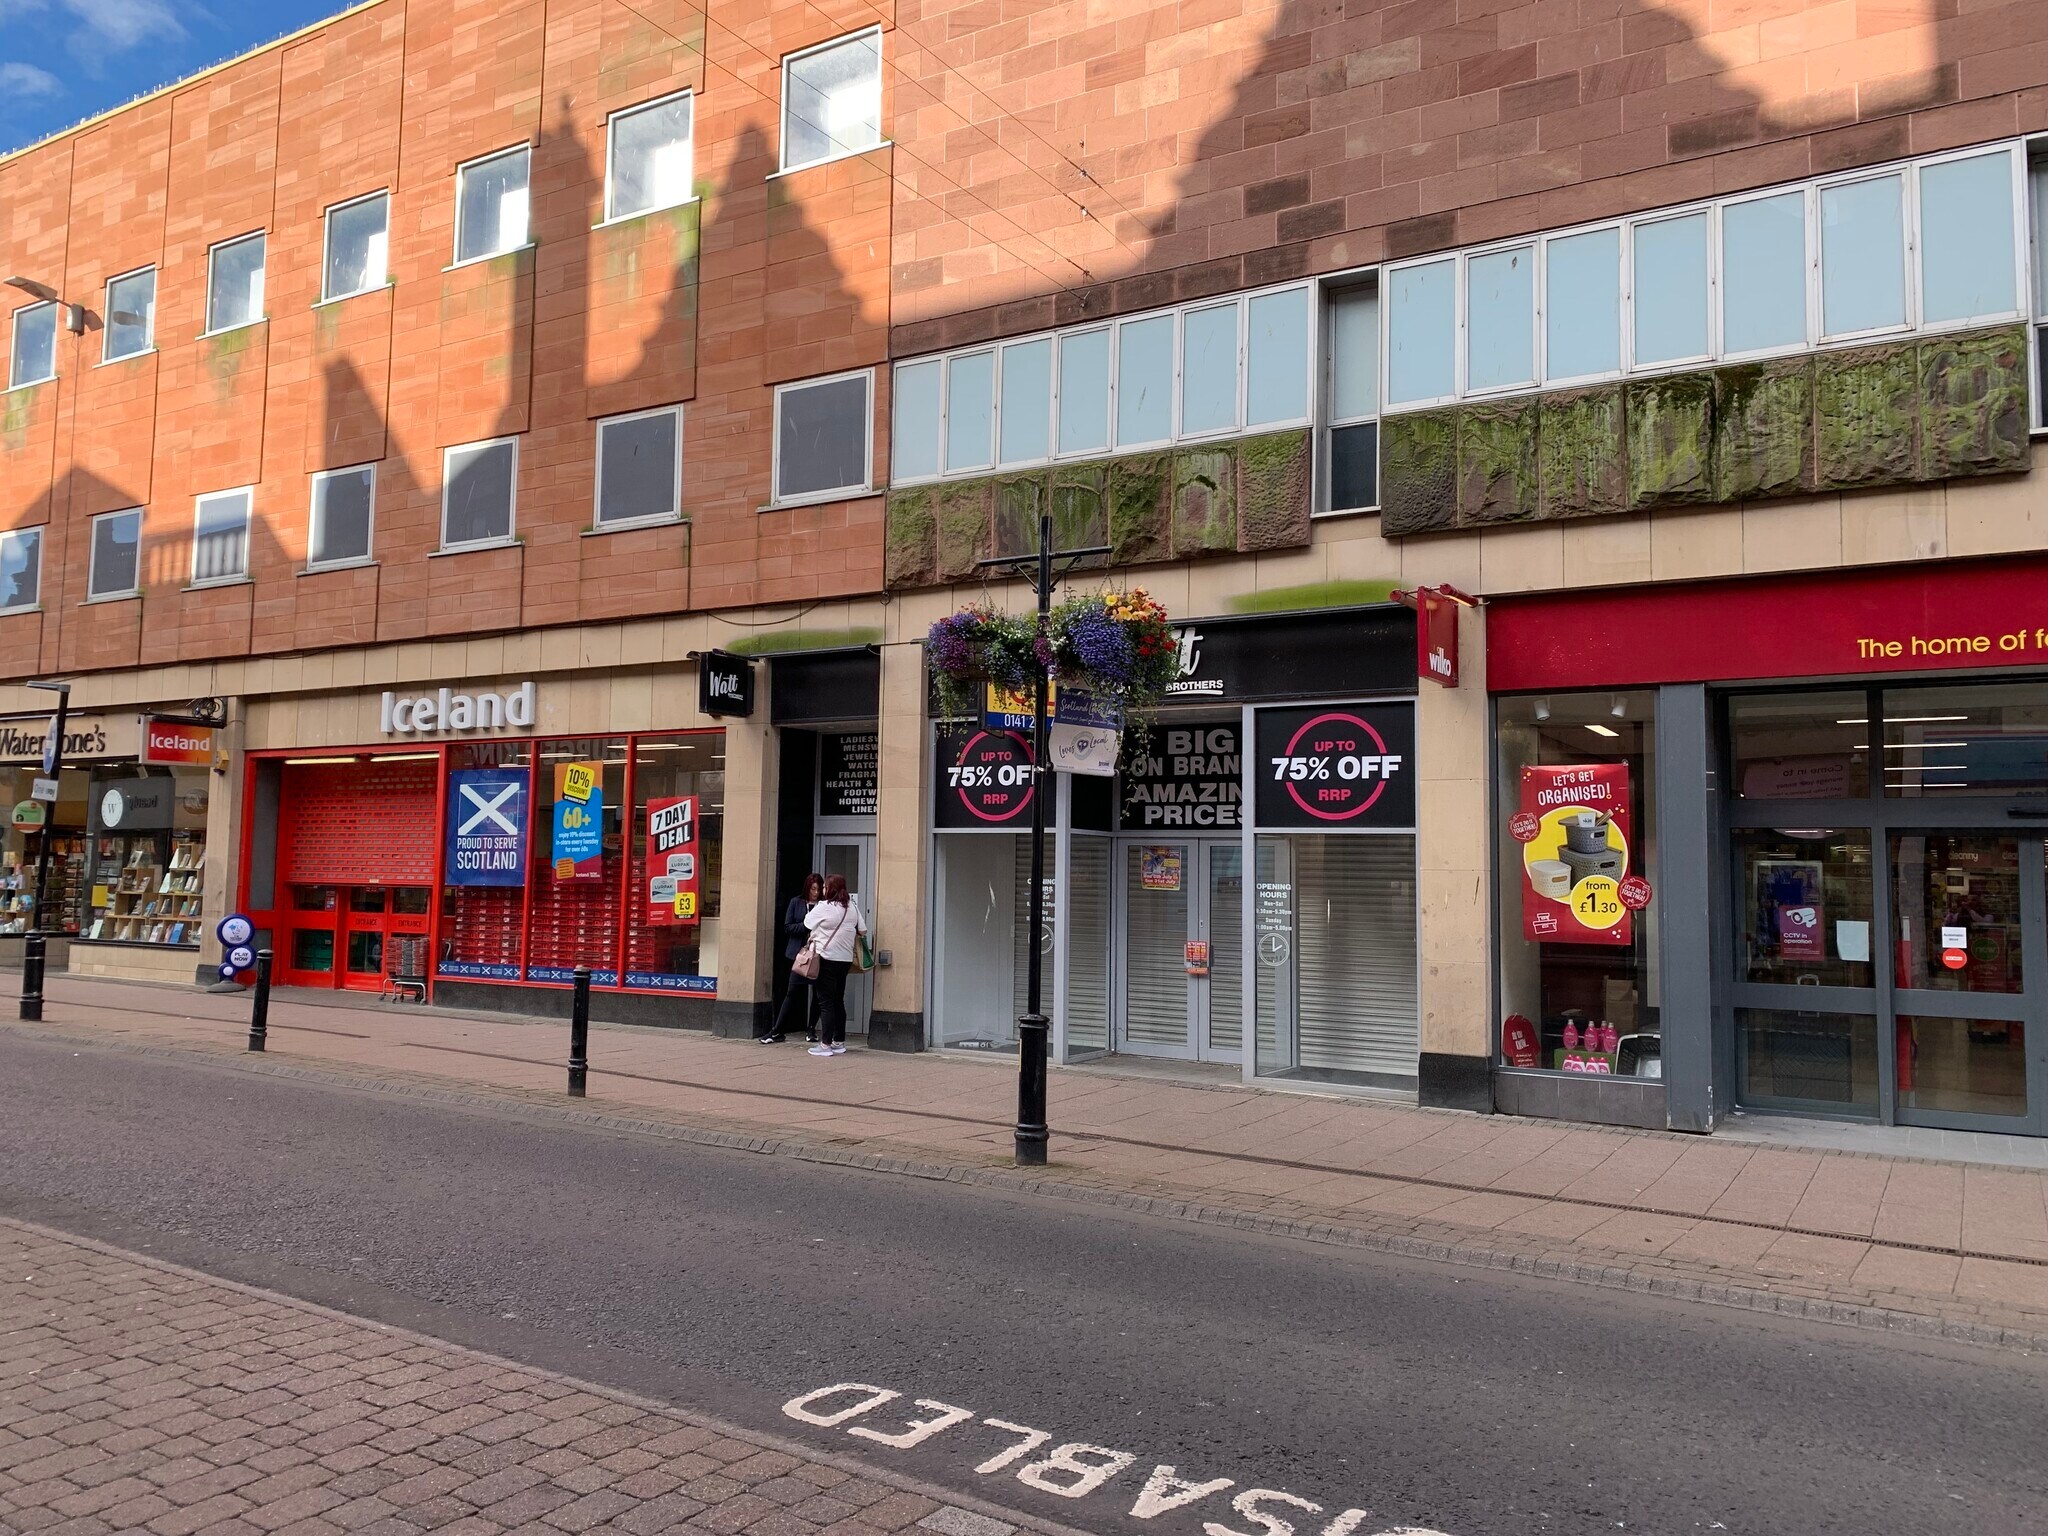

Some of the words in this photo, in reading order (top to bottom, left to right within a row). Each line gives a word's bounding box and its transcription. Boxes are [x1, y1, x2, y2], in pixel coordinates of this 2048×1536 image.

[1857, 638, 1902, 658] The
[1911, 635, 1991, 656] home
[1999, 629, 2027, 651] of
[2035, 628, 2048, 649] f
[1429, 647, 1452, 677] wilko
[710, 671, 739, 696] Watt
[1165, 679, 1224, 692] BROTHERS
[380, 681, 536, 734] Iceland
[1004, 713, 1026, 728] 0141
[0, 723, 106, 756] Waterone's
[150, 732, 211, 752] Iceland
[1167, 728, 1235, 755] BIG
[1314, 741, 1334, 753] UP
[1336, 740, 1356, 751] TO
[981, 751, 996, 762] UP
[997, 751, 1012, 761] TO
[947, 765, 993, 787] 75%
[1131, 757, 1163, 777] ON
[1271, 756, 1330, 780] 75%
[1337, 755, 1402, 780] OFF
[569, 768, 590, 788] 10%
[826, 780, 862, 788] HEALTH
[866, 779, 873, 787] &
[1552, 773, 1575, 787] LET'S
[1578, 770, 1595, 782] GET
[567, 784, 588, 796] DISCOUNT
[983, 793, 1008, 805] RRP
[1318, 788, 1352, 801] RRP
[1538, 782, 1612, 806] ORGANISED!
[563, 806, 591, 829] 60+
[655, 813, 662, 831] 7
[665, 803, 687, 827] DAY
[457, 837, 482, 849] PROUD
[484, 837, 493, 849] TO
[494, 837, 518, 849] SERVE
[660, 824, 691, 851] DEAL
[457, 851, 517, 869] SCOTLAND
[1259, 891, 1288, 899] HOURS
[1585, 881, 1610, 890] from
[679, 897, 691, 911] £3
[1580, 892, 1618, 913] £1.30
[398, 920, 422, 928] ENTRANCE
[783, 1383, 1453, 1536] ISABLED
